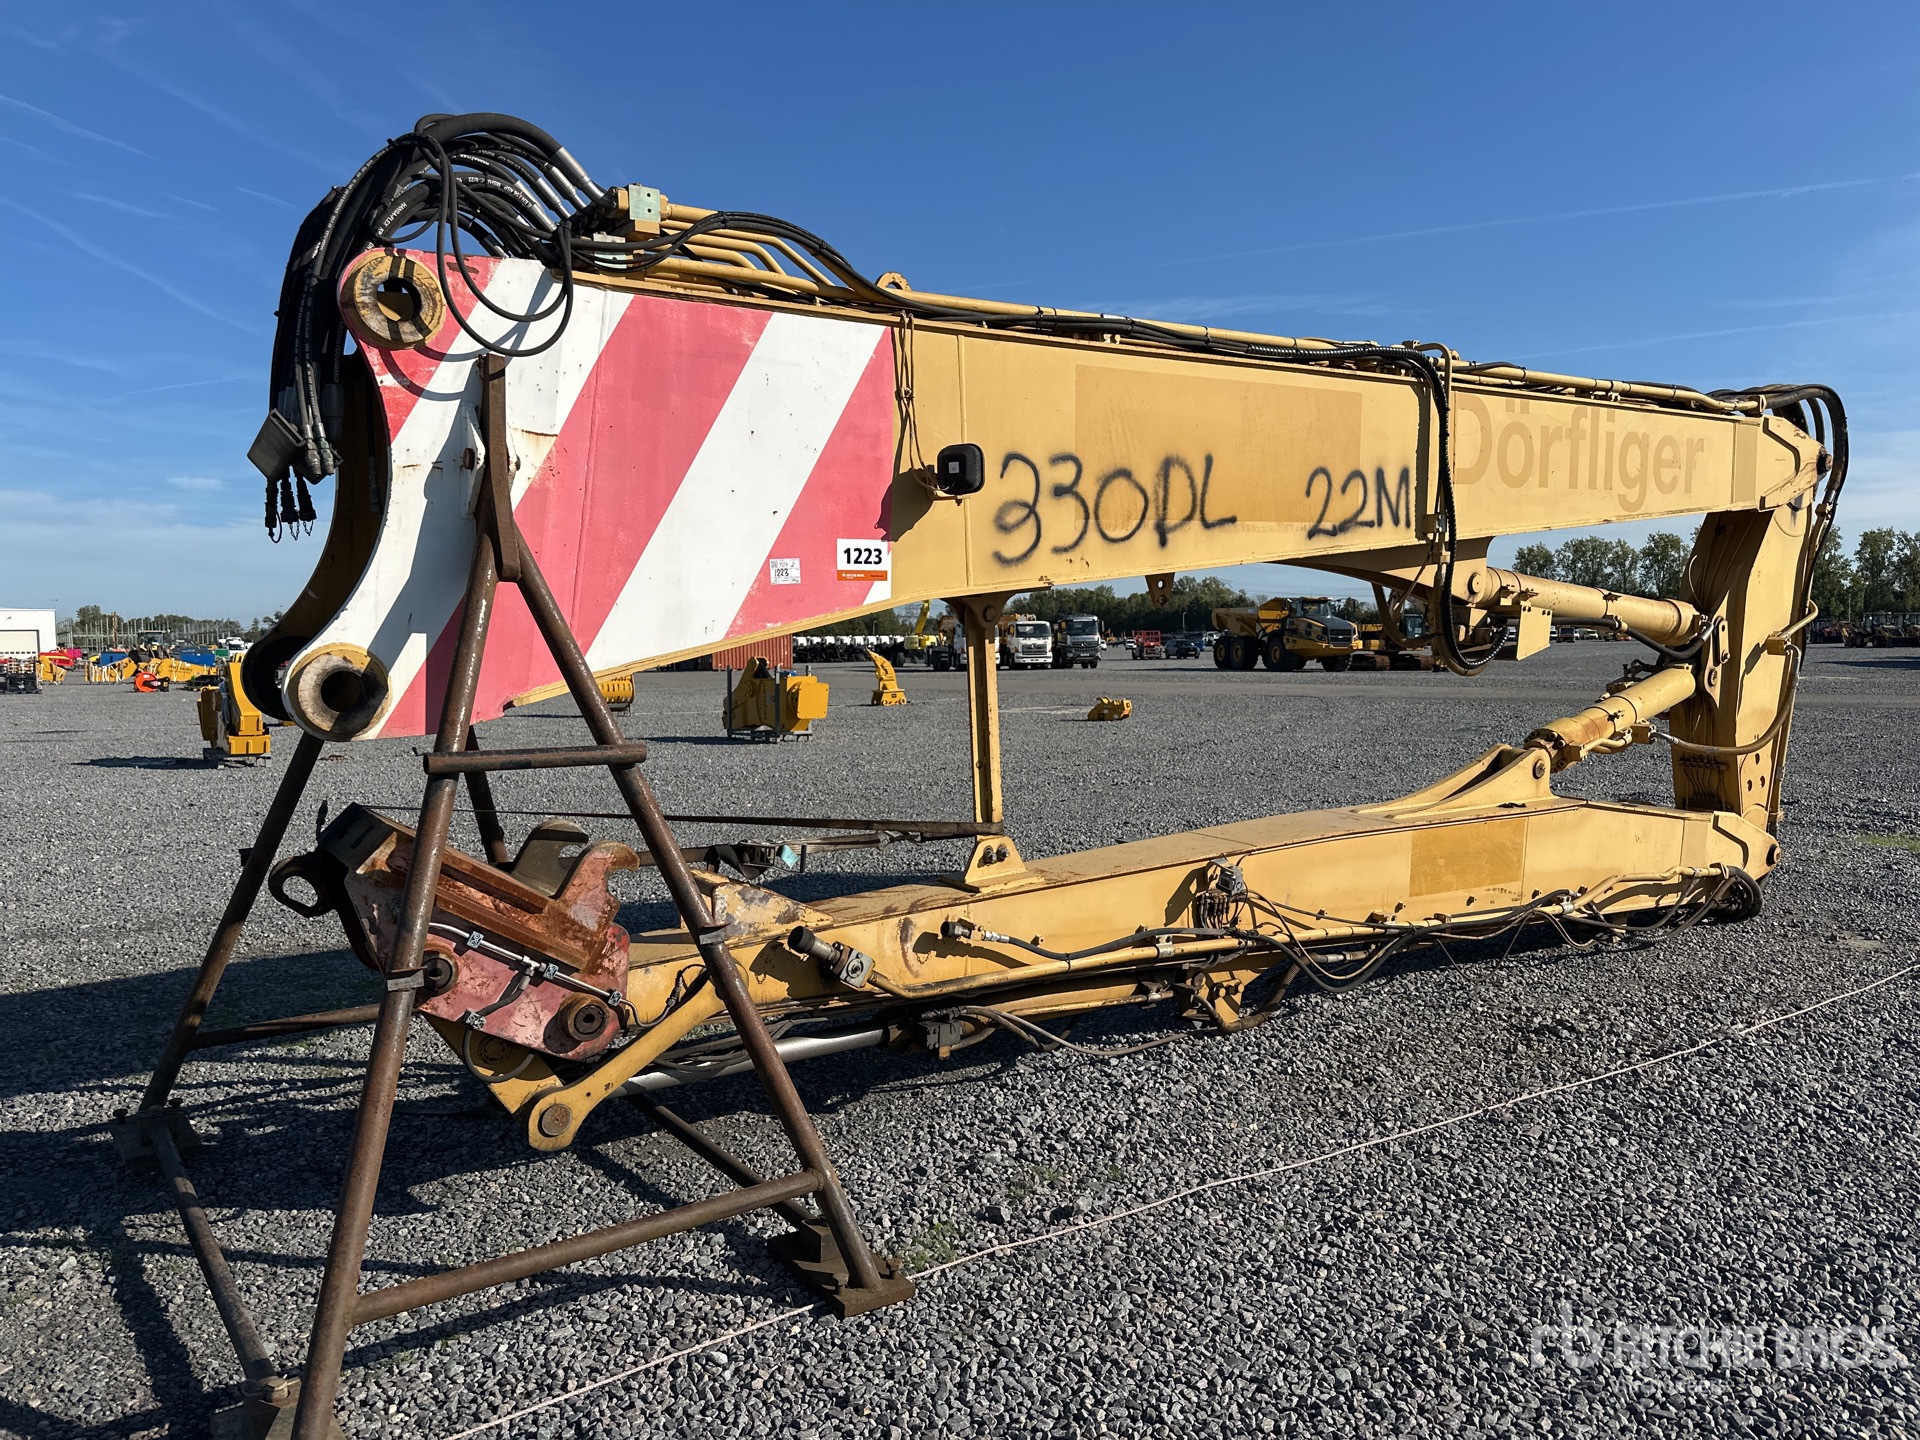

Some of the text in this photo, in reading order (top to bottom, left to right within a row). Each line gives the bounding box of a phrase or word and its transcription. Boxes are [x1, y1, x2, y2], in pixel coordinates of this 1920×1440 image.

[1454, 392, 1704, 513] Dörfliger
[1304, 464, 1412, 540] 22M
[775, 567, 790, 578] 1223
[843, 547, 883, 565] 1223
